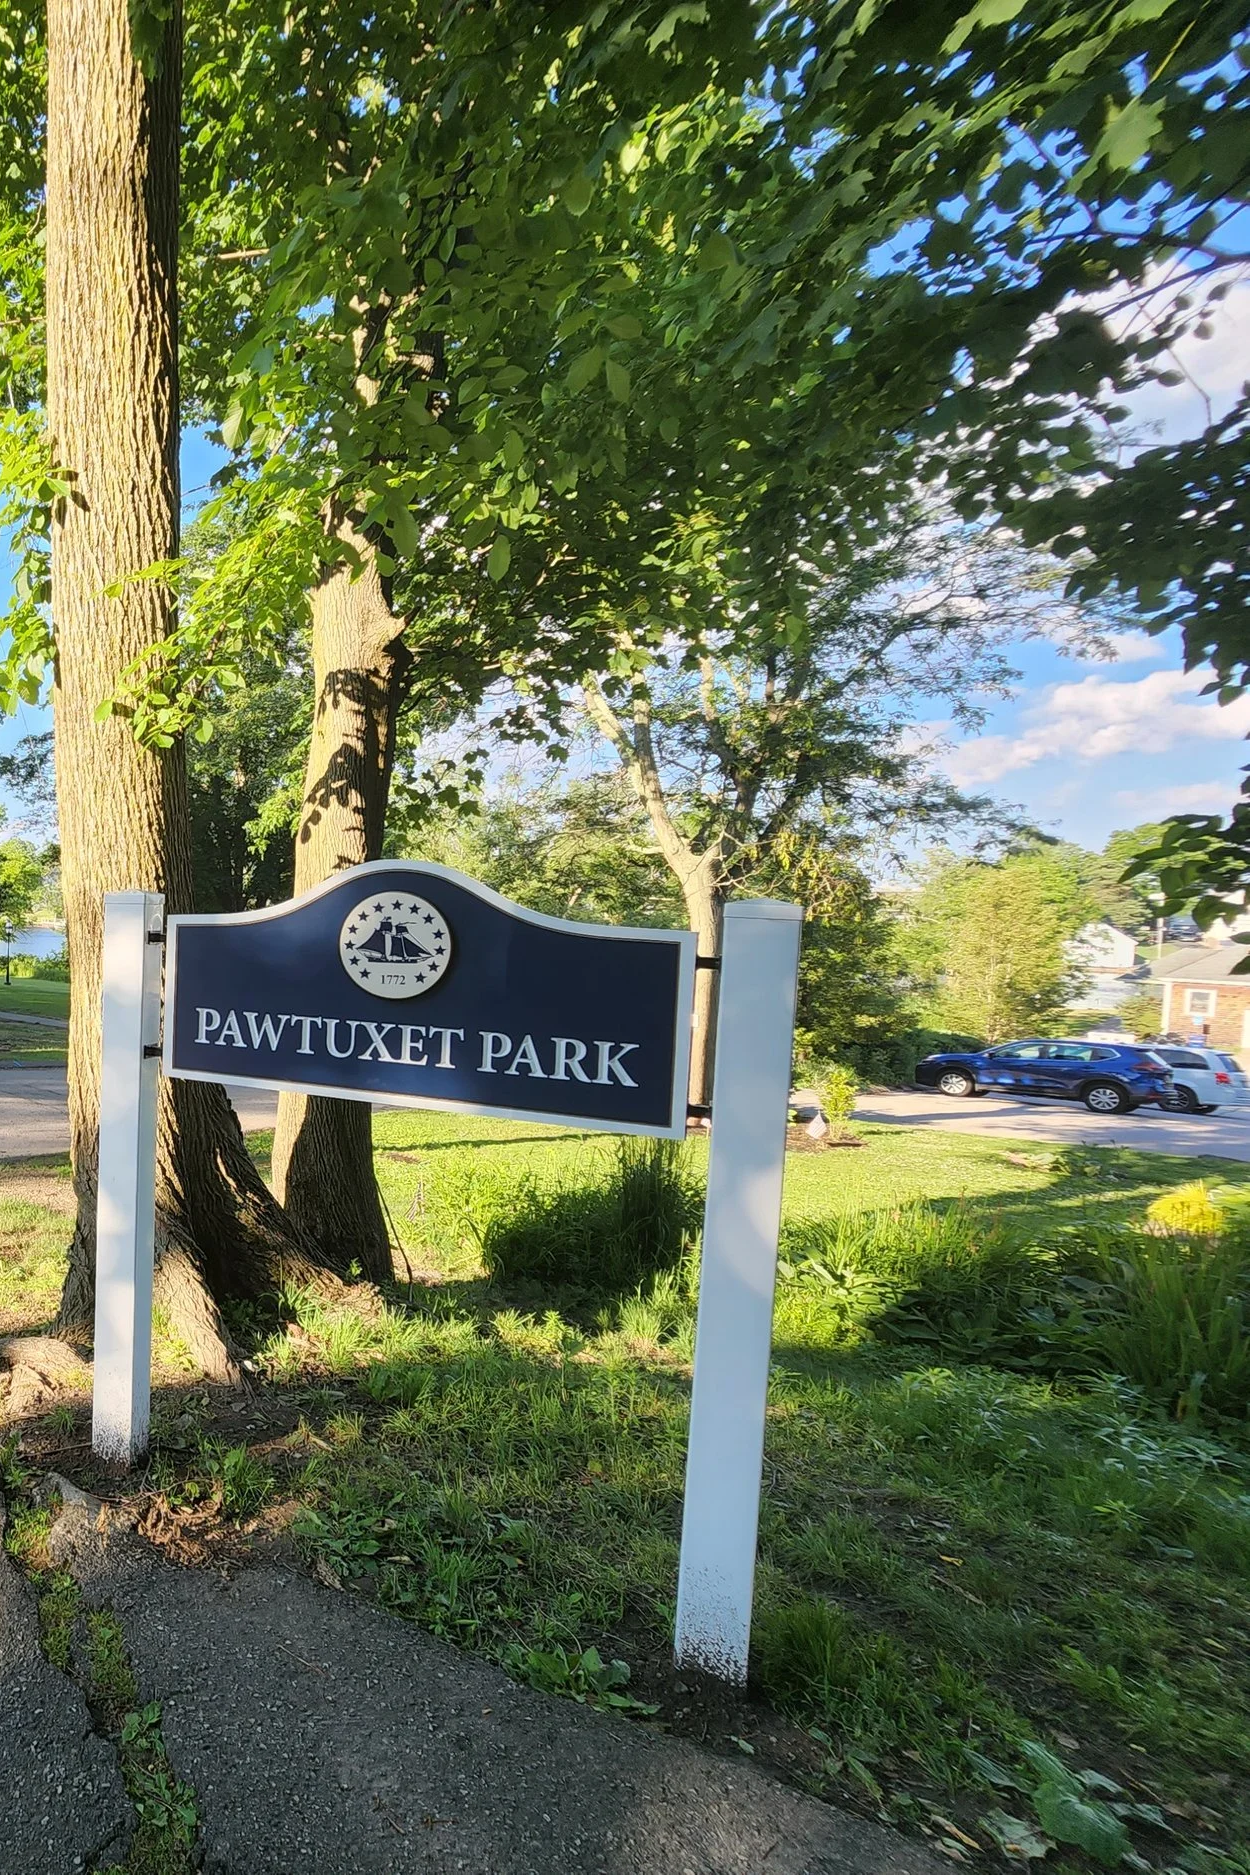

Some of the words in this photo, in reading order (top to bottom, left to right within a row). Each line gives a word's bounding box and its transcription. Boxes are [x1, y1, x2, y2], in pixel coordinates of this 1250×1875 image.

[381, 975, 406, 985] 1772
[195, 1008, 464, 1069] PAWTUXET
[478, 1032, 638, 1087] PARK
